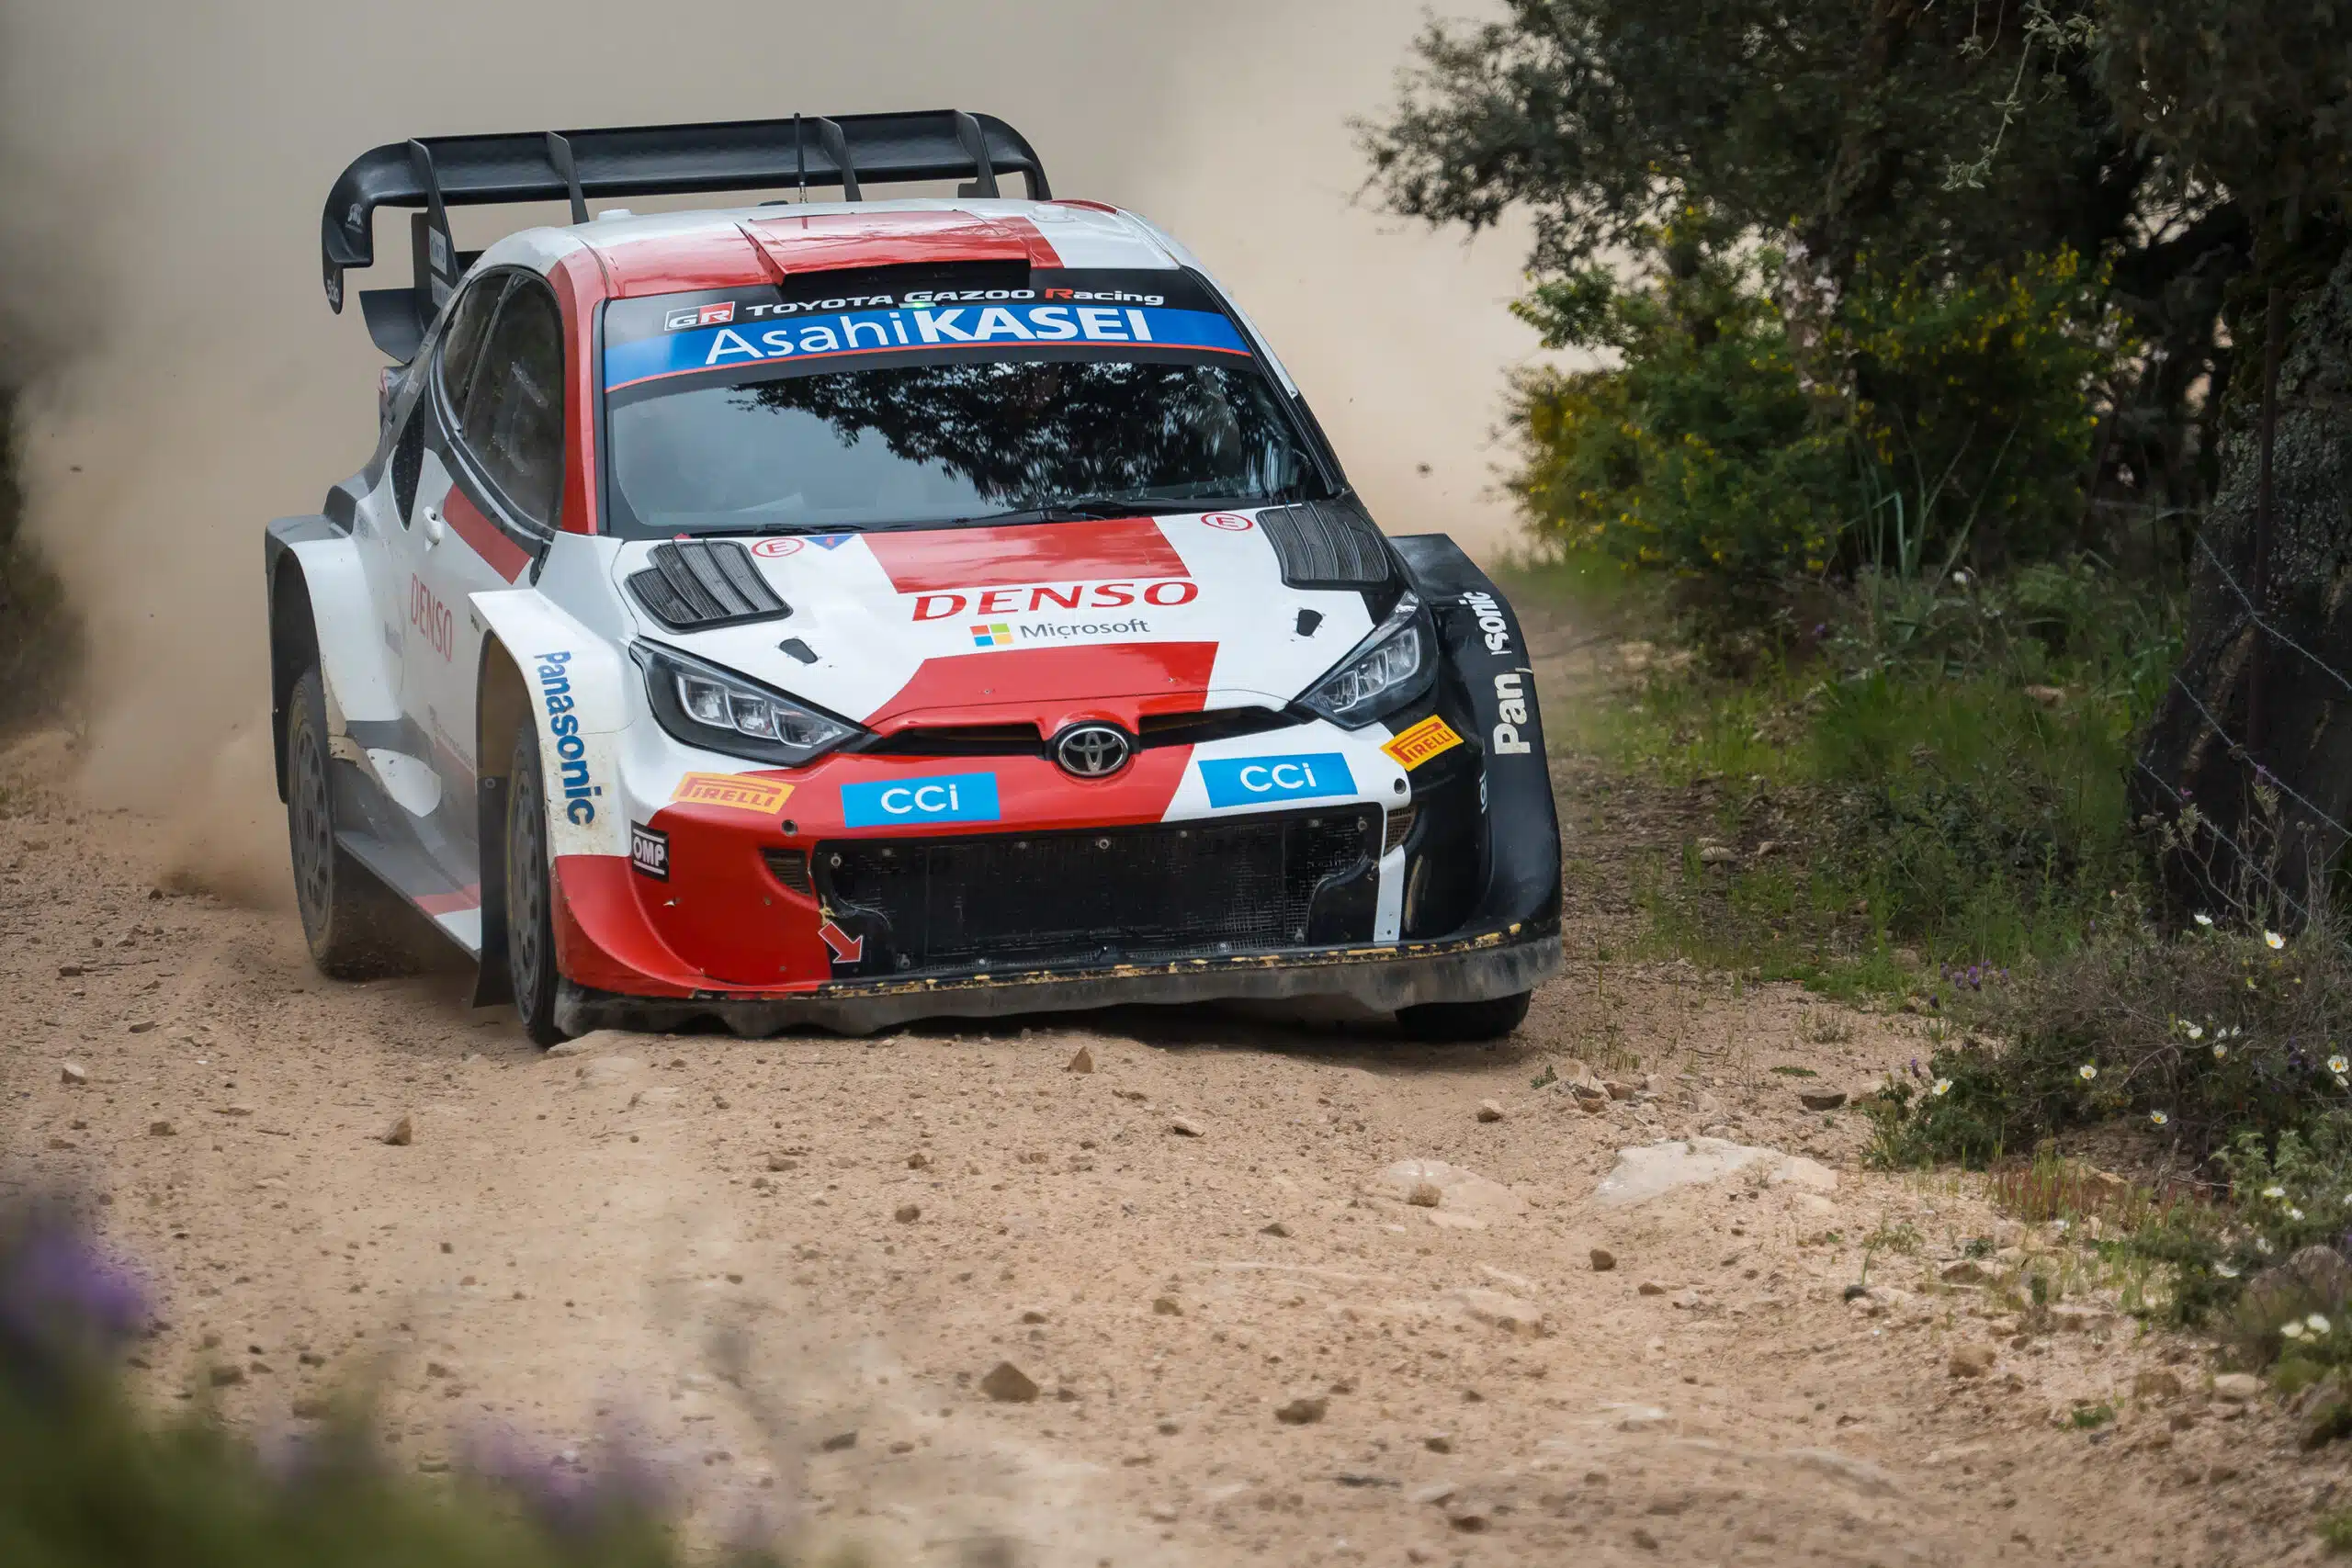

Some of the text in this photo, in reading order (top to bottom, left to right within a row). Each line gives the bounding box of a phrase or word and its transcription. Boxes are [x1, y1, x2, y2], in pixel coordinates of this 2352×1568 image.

[746, 288, 1165, 317] TOYOTA GAZOO Racing
[669, 310, 730, 329] GR
[411, 572, 453, 662] DENSO
[911, 581, 1199, 622] DENSO
[1020, 618, 1151, 638] Microsoft
[534, 650, 603, 826] Panasonic
[1389, 721, 1454, 764] PIRELLI
[679, 777, 783, 807] PIRELLI
[632, 835, 666, 867] OMP
